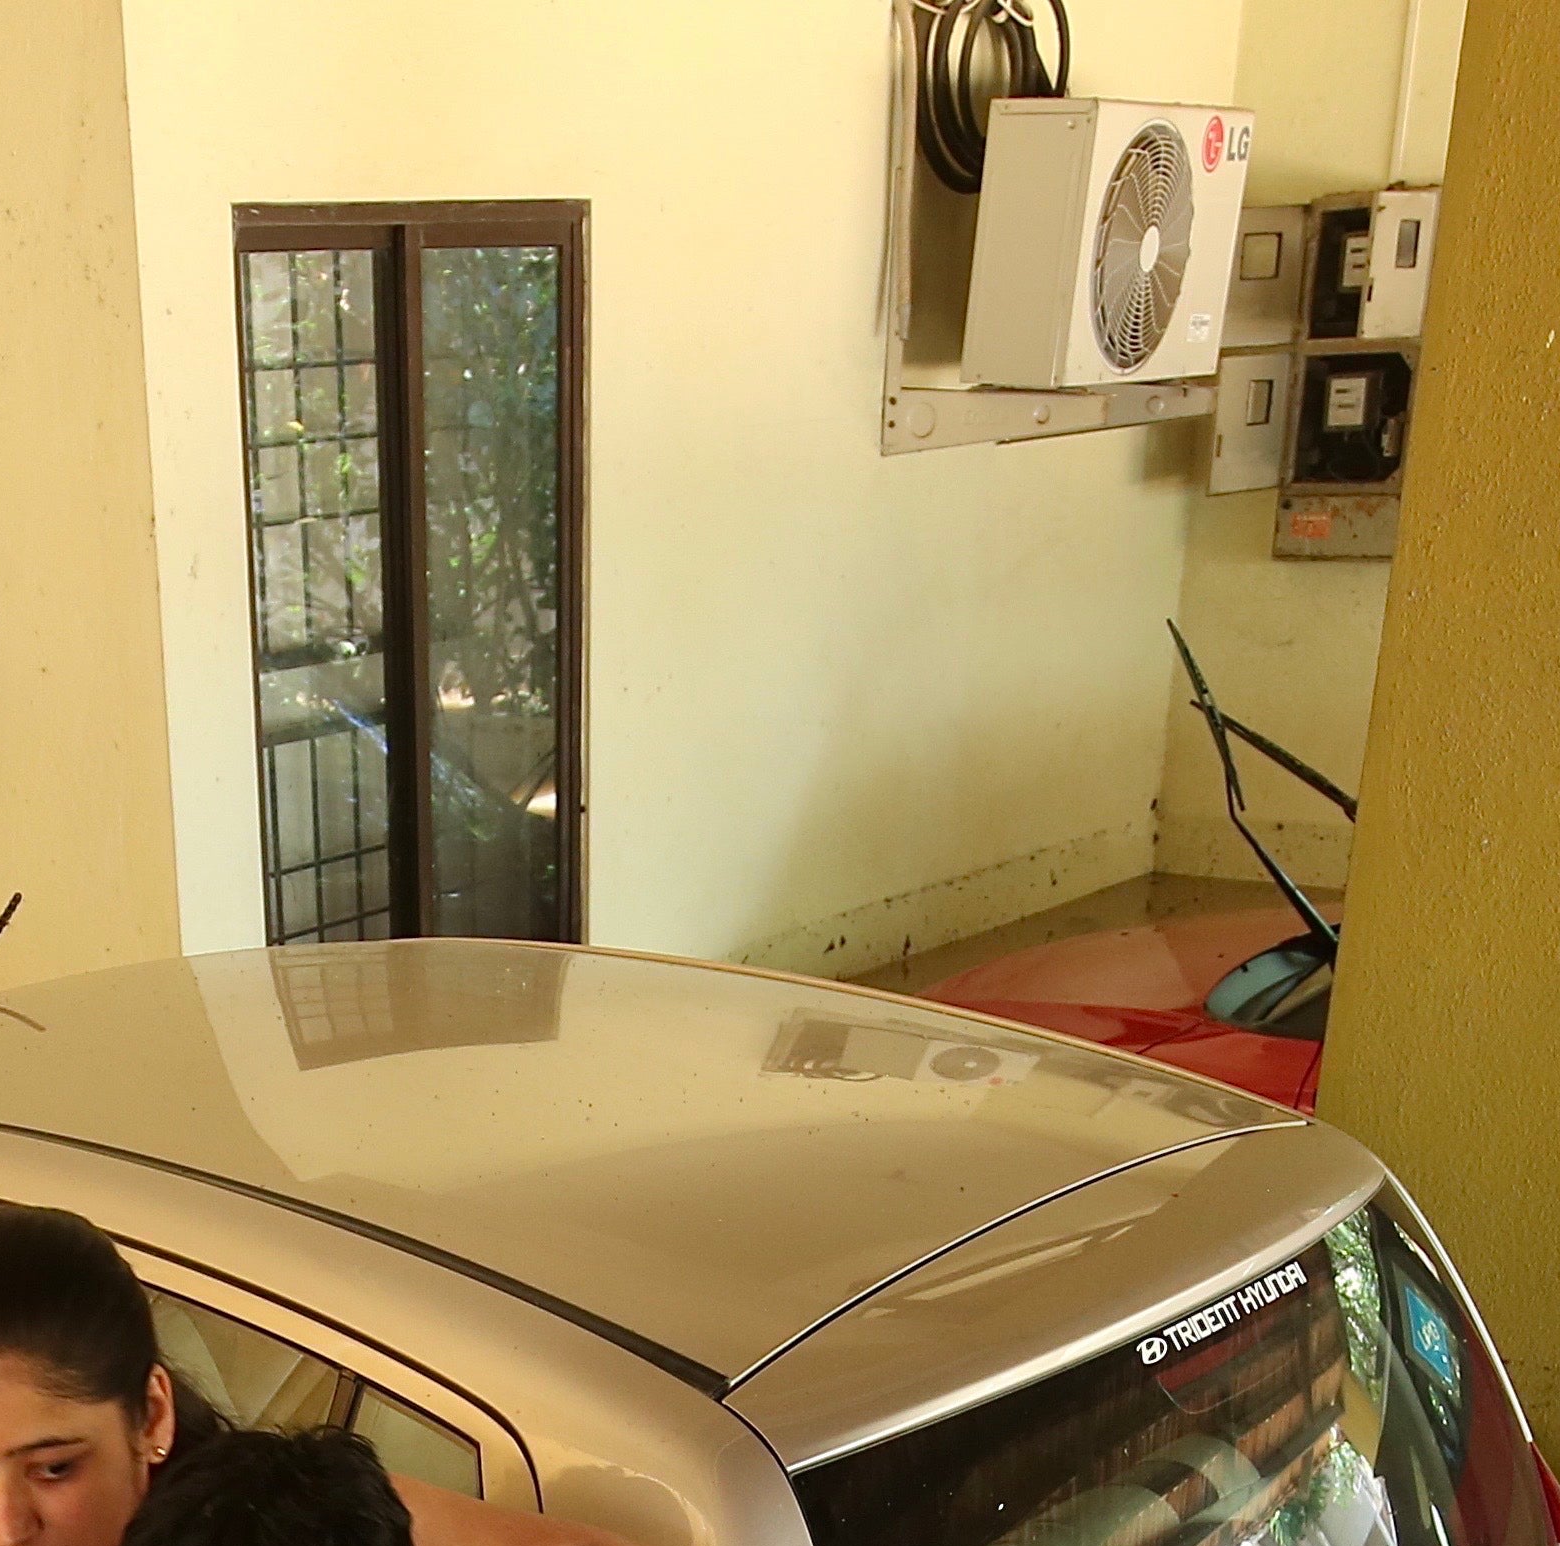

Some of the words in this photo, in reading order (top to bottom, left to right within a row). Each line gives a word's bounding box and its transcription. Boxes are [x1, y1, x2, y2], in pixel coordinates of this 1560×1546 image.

[1226, 125, 1251, 162] LG
[1163, 1295, 1241, 1351] TRIDENT
[1237, 1261, 1308, 1314] HYUNDAI
